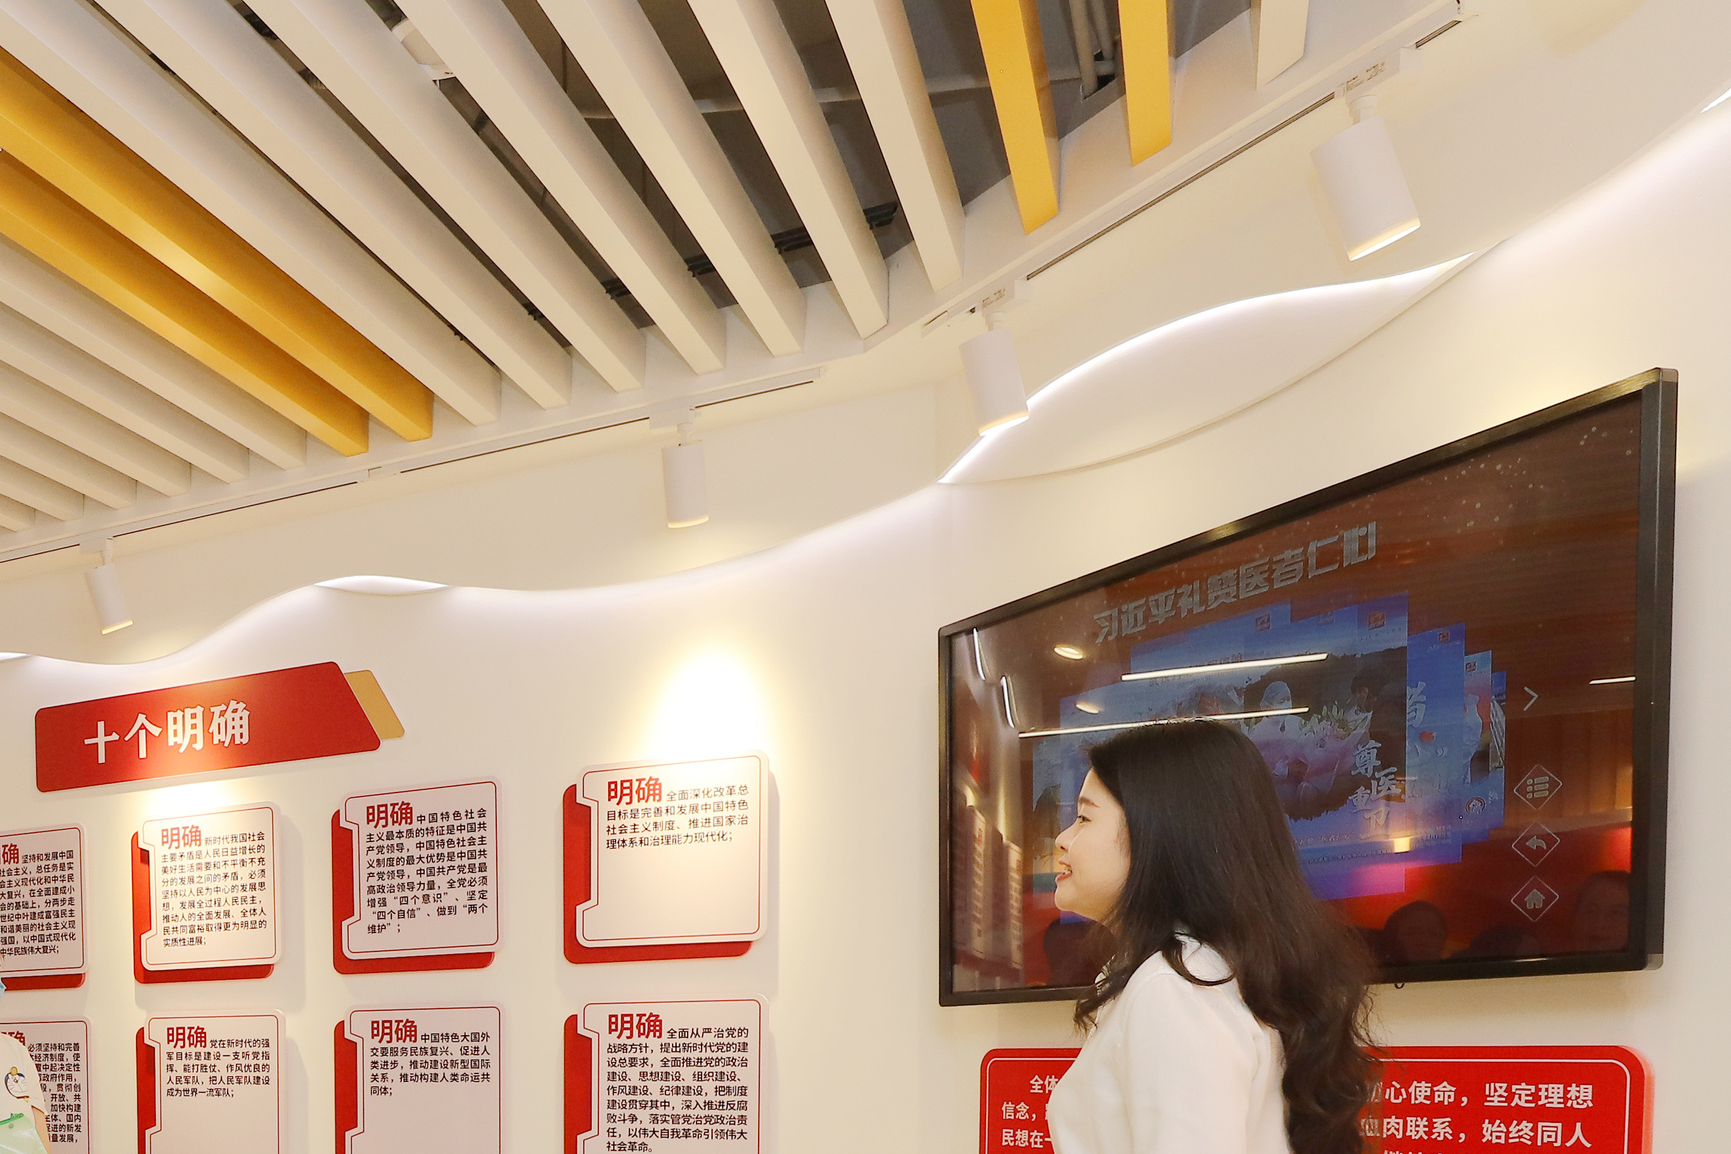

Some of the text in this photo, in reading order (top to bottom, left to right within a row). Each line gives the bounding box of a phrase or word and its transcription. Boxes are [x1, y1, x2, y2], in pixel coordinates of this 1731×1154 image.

[1093, 521, 1376, 643] 习近平礼赞医者仁心
[84, 699, 250, 763] 十个明确
[608, 776, 749, 806] 明确 全面深化改革总
[367, 801, 487, 828] 明确 中国特色社会
[607, 799, 749, 821] 目标是完善和发展中国特色
[366, 822, 487, 843] 主义最本质的特征是中国共
[606, 815, 748, 835] 社会主义制度、推进国家治
[161, 825, 265, 850] 明确 新时代我国社会
[366, 835, 487, 856] 产党领导，中国特色社会主
[22, 850, 73, 864] 坚持和发展中国
[161, 844, 265, 863] 主要矛盾是人民日益增长的
[367, 849, 487, 869] 义制度的最大优势是中国共
[162, 857, 265, 875] 美好生活需要和不平衡不充
[367, 863, 488, 882] 产党领导，中国共产党是最
[162, 869, 266, 887] 分的发展之间的矛盾，必须
[367, 876, 488, 895] 高政治领导力量，全党必须
[162, 882, 266, 899] 坚持以人民为中心的发展思
[163, 907, 266, 923] 推动人的全面发展、全体人
[163, 920, 267, 936] 民共同富裕取得更为明显的
[371, 1019, 490, 1044] 明确 中国特色大国外
[608, 1013, 748, 1039] 明确 全面从严治党的
[167, 1026, 270, 1048] 明确 党在新时代的强
[28, 1043, 80, 1052] 必须坚持和完善
[166, 1051, 270, 1060] 军目标是建设一支听党指
[370, 1046, 490, 1057] 交要服务民族复兴、促进人
[607, 1042, 748, 1054] 战略方针，提出新时代党的建
[167, 1064, 270, 1073] 挥、能打胜仗、作风优良的
[371, 1059, 490, 1070] 类进步，推动建设新型国际
[607, 1057, 748, 1068] 设总要求，全面推进党的政治
[167, 1076, 270, 1085] 人民军队，把人民军队建设
[371, 1073, 490, 1083] 关系，推动构建人类命运共
[607, 1071, 743, 1082] 建设、思想建设、组织建设、
[1030, 1075, 1059, 1093] 全体
[607, 1085, 748, 1097] 作风建设、纪律建设，把制度
[51, 1104, 81, 1112] 加快构建
[607, 1100, 747, 1111] 建设贯穿其中，深入推进反腐
[1002, 1102, 1048, 1121] 信念，
[607, 1114, 747, 1126] 败斗争，落实管党治党政治责
[607, 1128, 747, 1140] 任，以伟大自我革命引领伟大
[607, 1142, 652, 1152] 社会革命。
